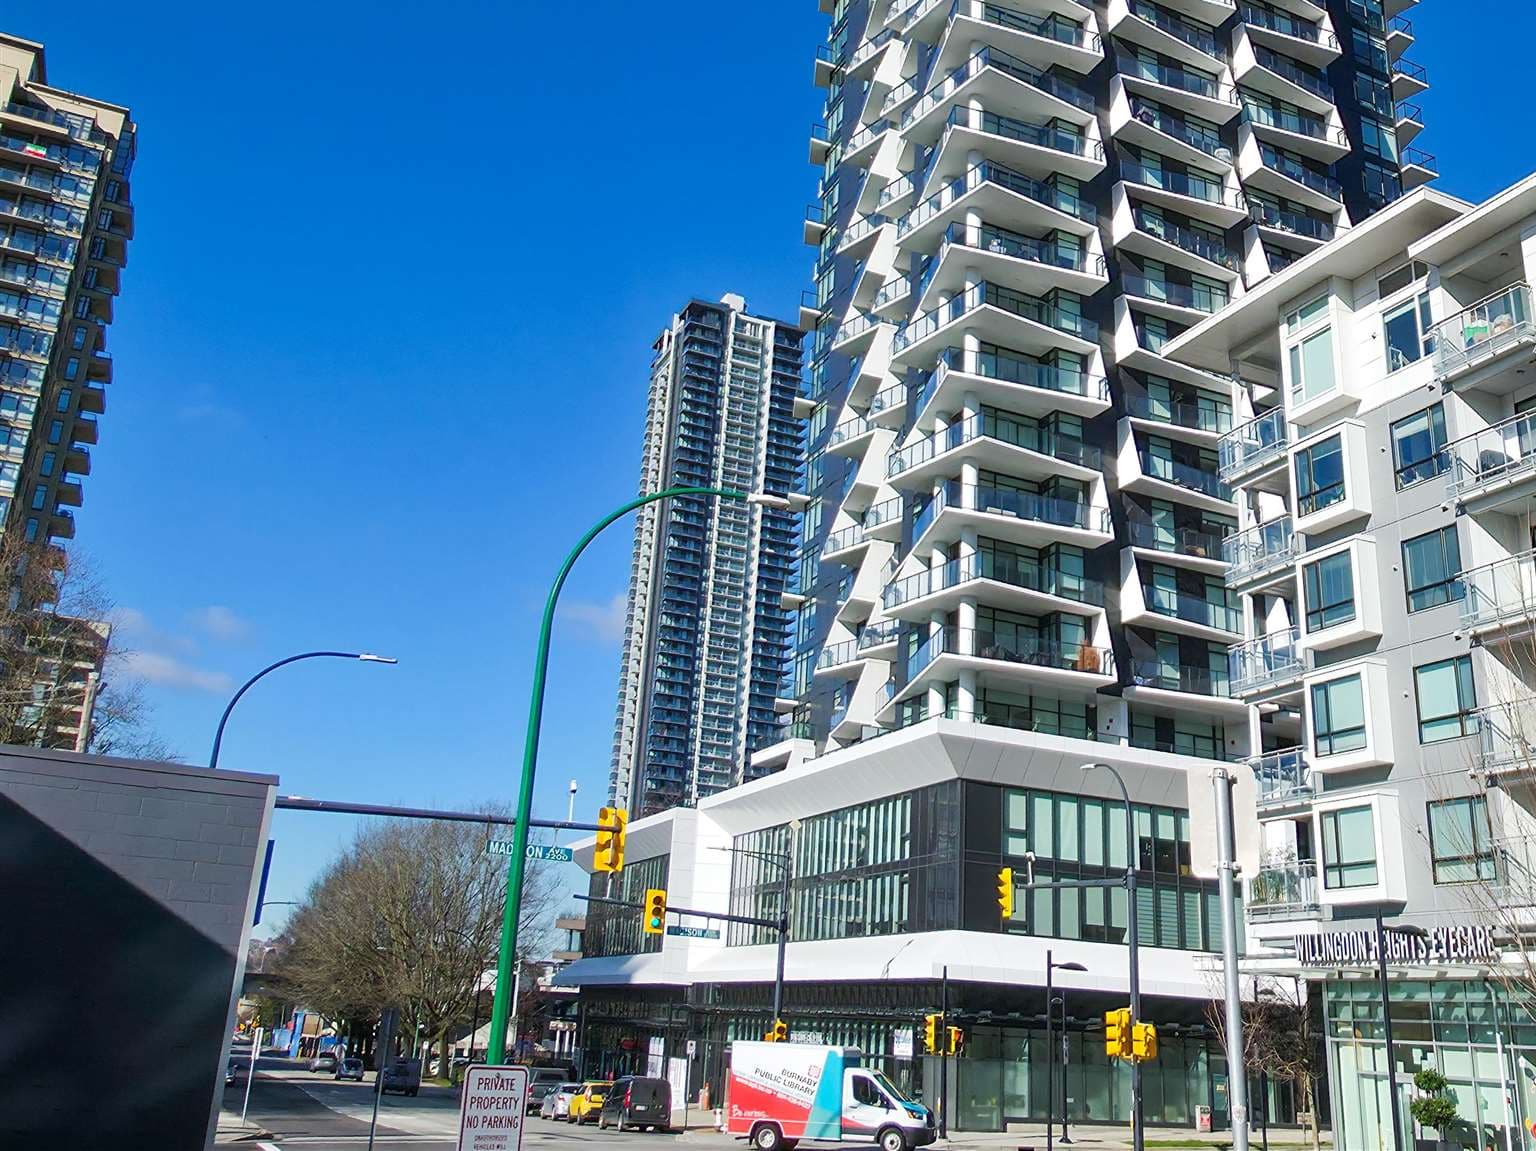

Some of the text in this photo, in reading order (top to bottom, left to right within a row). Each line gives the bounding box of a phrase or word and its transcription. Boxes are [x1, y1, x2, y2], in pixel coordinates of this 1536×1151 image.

[489, 841, 543, 858] MADON
[1295, 930, 1368, 961] WILLINGDON
[1431, 925, 1496, 959] EYECARE
[477, 1077, 517, 1091] PRIVATE
[754, 1067, 781, 1084] PUBLIC
[783, 1079, 815, 1096] LIBRARY
[781, 1068, 817, 1087] BURNABY
[469, 1096, 520, 1110] PROPERTY
[466, 1115, 519, 1129] NO PARKING
